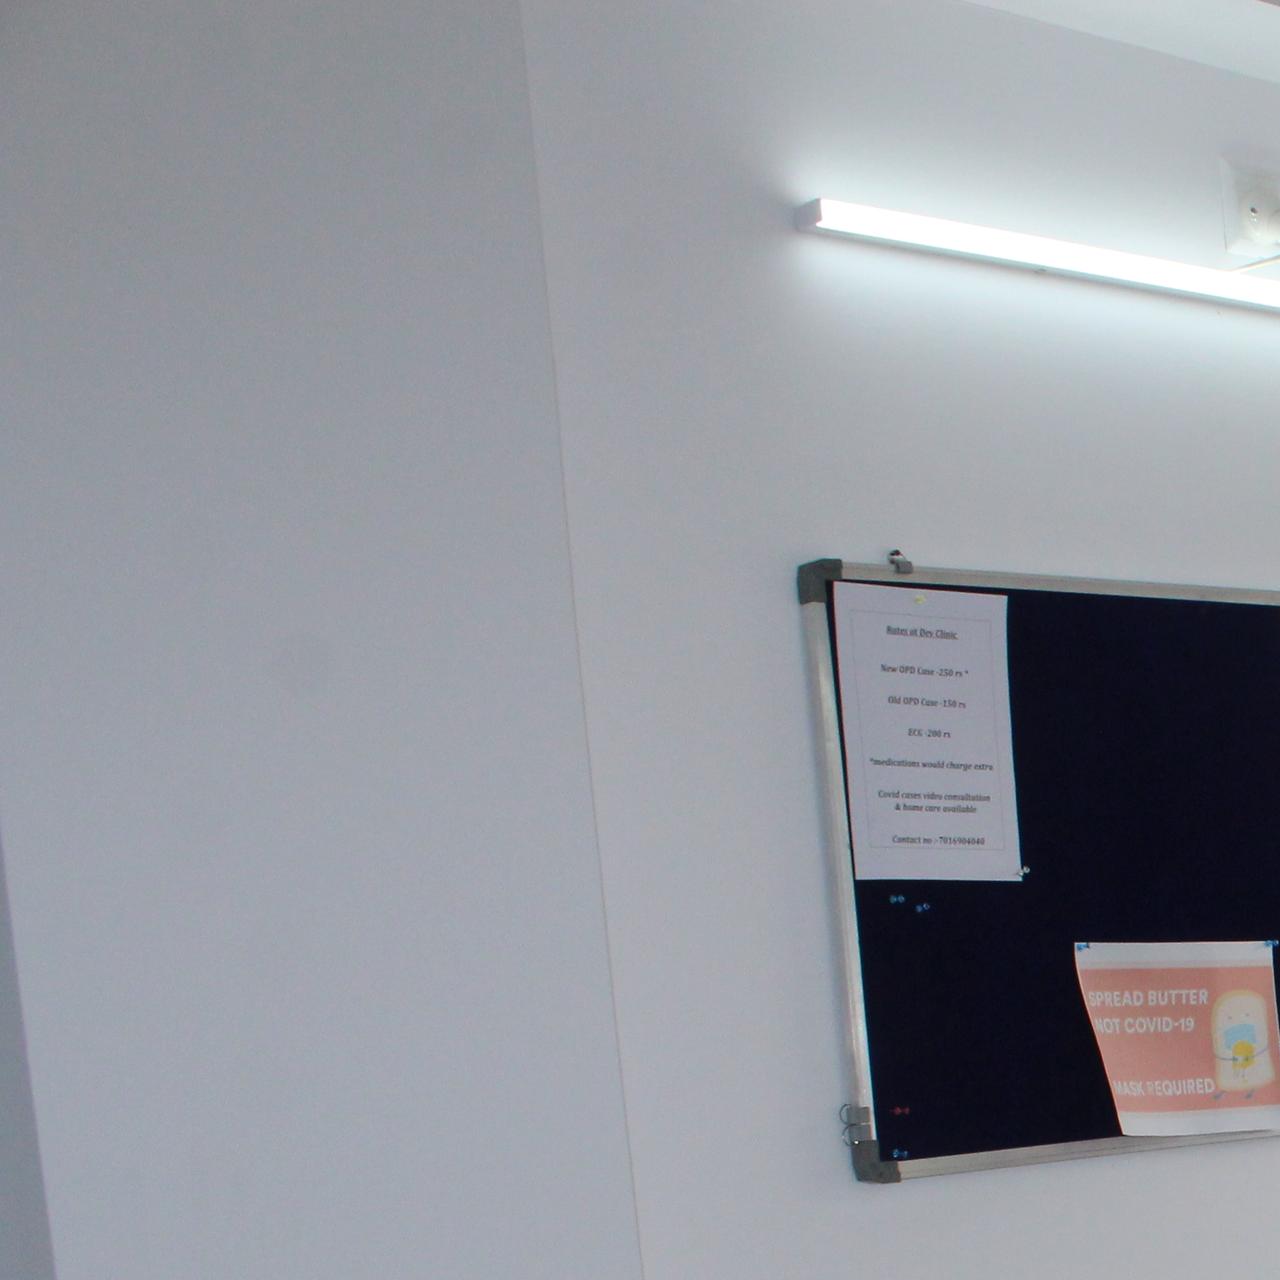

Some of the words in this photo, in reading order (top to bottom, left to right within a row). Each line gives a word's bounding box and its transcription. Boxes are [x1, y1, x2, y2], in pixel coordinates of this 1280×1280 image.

[935, 629, 958, 640] Clinic
[881, 663, 897, 673] New
[899, 665, 916, 674] OPD
[888, 695, 901, 705] Old
[903, 696, 919, 705] OPD
[921, 761, 945, 769] would
[946, 761, 972, 771] charge
[974, 763, 993, 771] extra
[878, 790, 900, 799] Covid
[892, 834, 921, 845] Contact
[1088, 990, 1144, 1007] SPREAD
[1147, 988, 1209, 1006] BUTTER
[1094, 1017, 1121, 1034] NOT
[1124, 1015, 1196, 1034] COVID-19
[1113, 1080, 1145, 1097] MASK
[1146, 1077, 1216, 1096] REQUIRED
